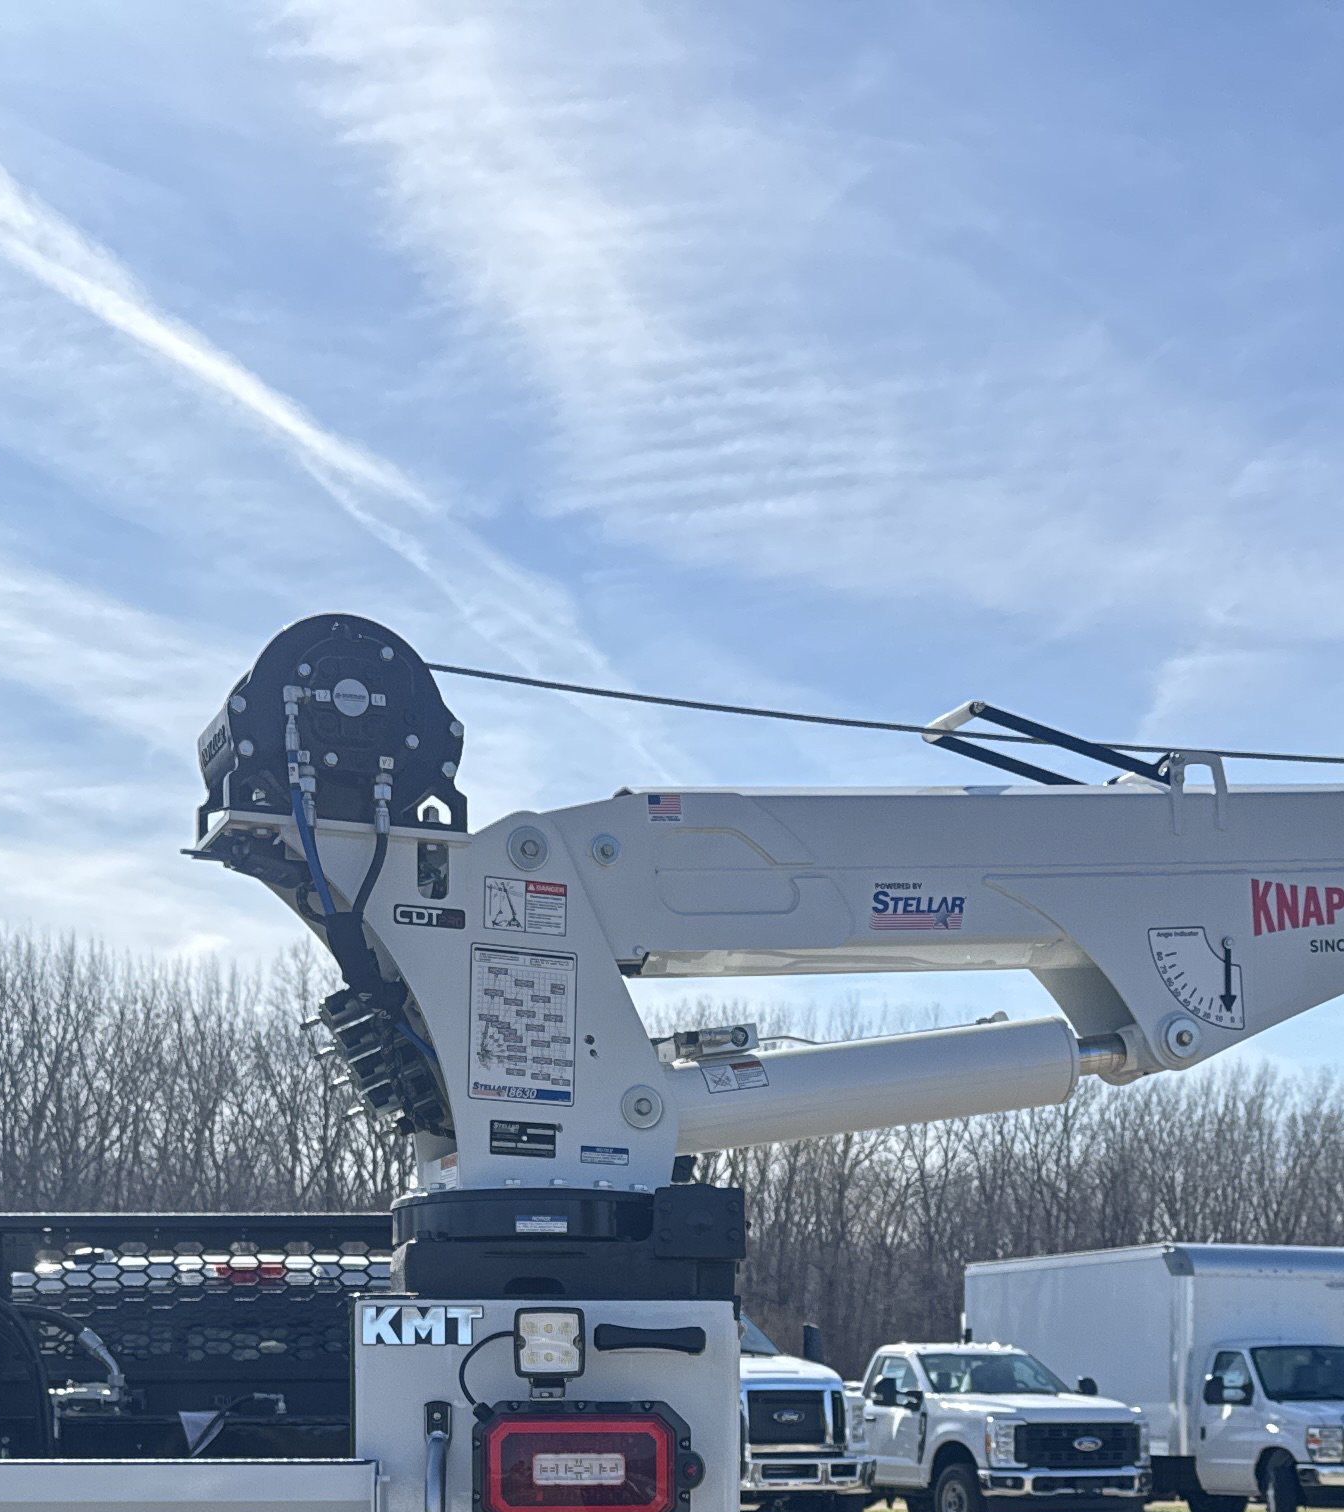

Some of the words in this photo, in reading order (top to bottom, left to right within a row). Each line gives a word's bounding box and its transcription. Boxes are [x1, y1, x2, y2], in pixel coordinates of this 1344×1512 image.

[872, 891, 965, 914] STELLAR
[508, 1087, 537, 1099] 8630
[362, 1306, 483, 1345] KMT
